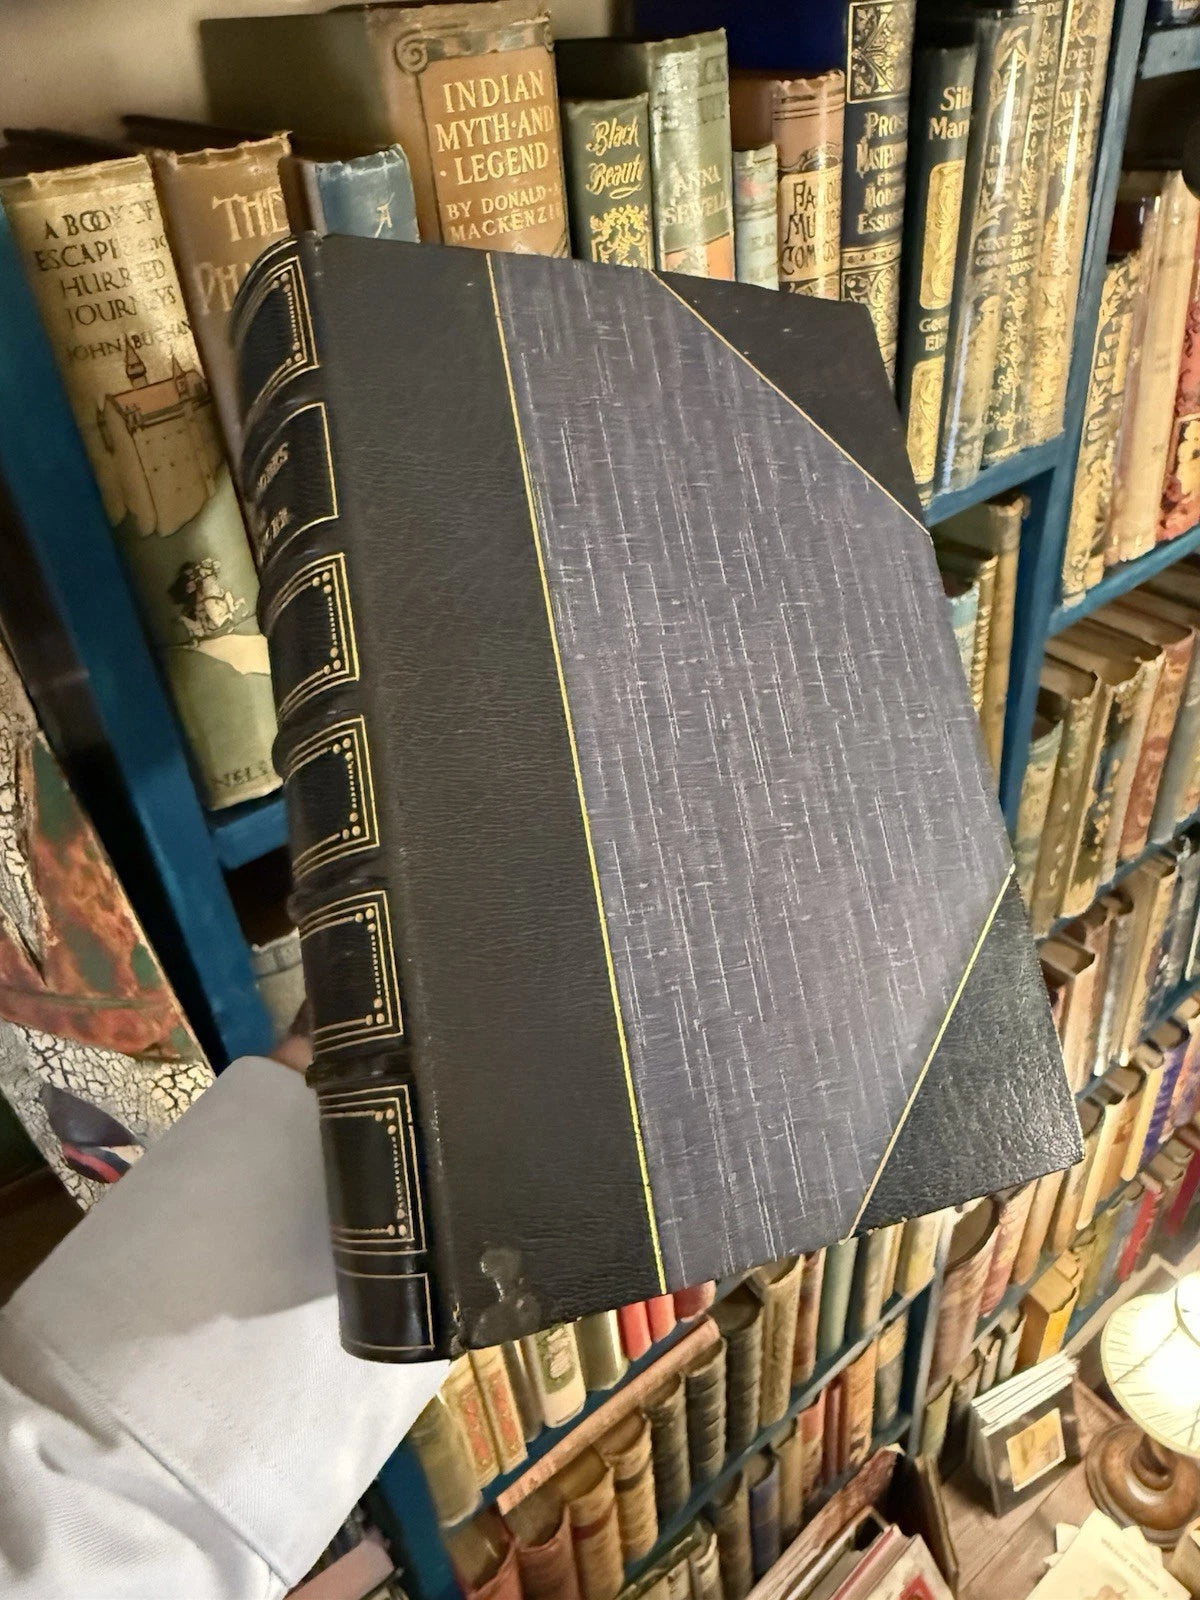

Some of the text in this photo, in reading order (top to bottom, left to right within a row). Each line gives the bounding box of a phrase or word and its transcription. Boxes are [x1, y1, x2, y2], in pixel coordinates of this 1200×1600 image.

[443, 69, 545, 113] INDIAN
[585, 115, 640, 157] Black
[454, 142, 549, 185] LEGEND
[212, 187, 290, 242] THE
[446, 201, 472, 219] BY
[481, 185, 546, 214] DONALD
[45, 219, 60, 239] A
[60, 259, 167, 298] HURRED
[194, 262, 250, 315] PH
[65, 285, 177, 330] JOURYS
